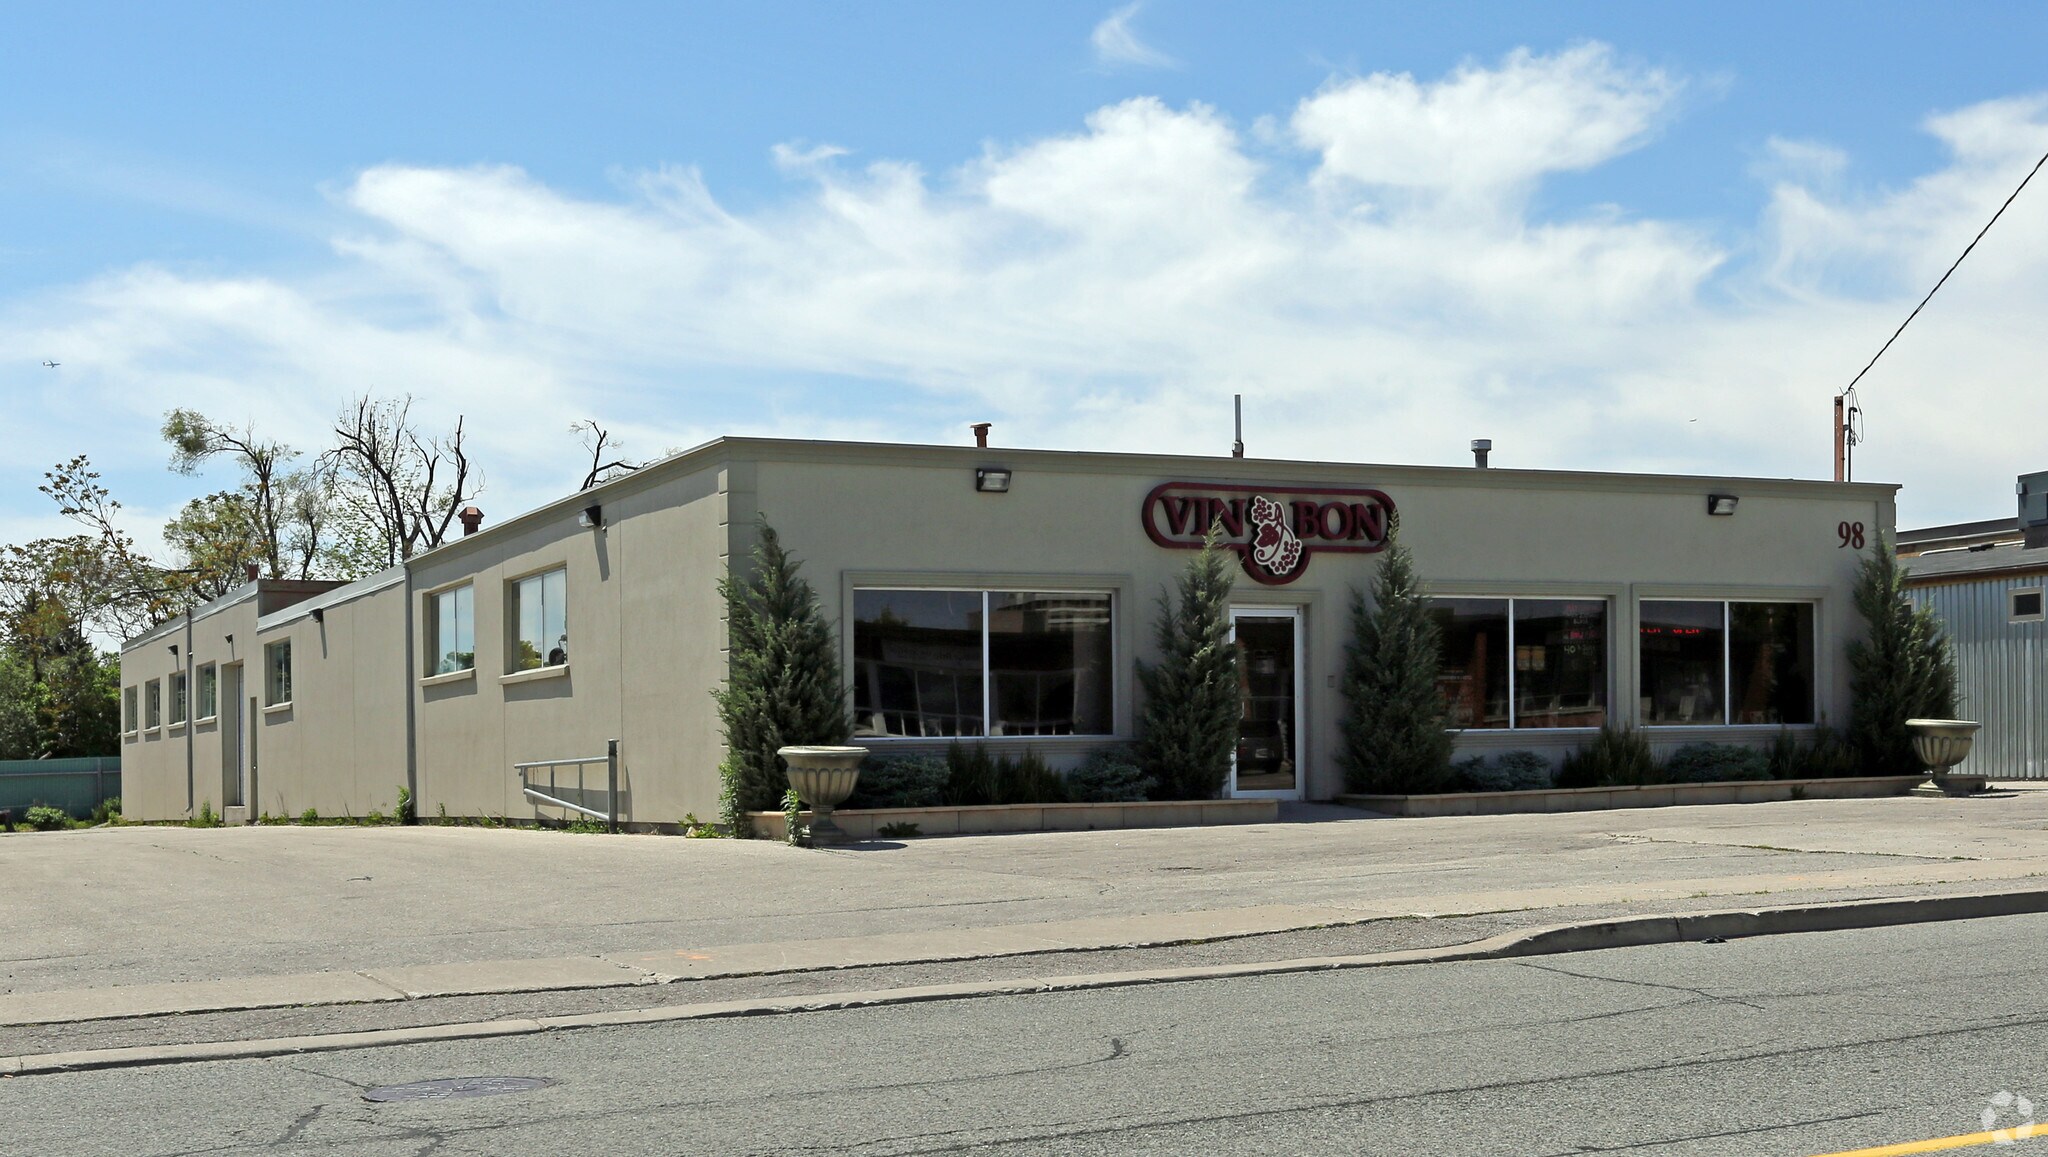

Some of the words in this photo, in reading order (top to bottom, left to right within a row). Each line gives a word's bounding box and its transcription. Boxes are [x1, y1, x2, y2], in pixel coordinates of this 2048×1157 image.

[1160, 496, 1245, 537] VIN
[1290, 501, 1382, 541] BON
[1838, 521, 1865, 550] 98
